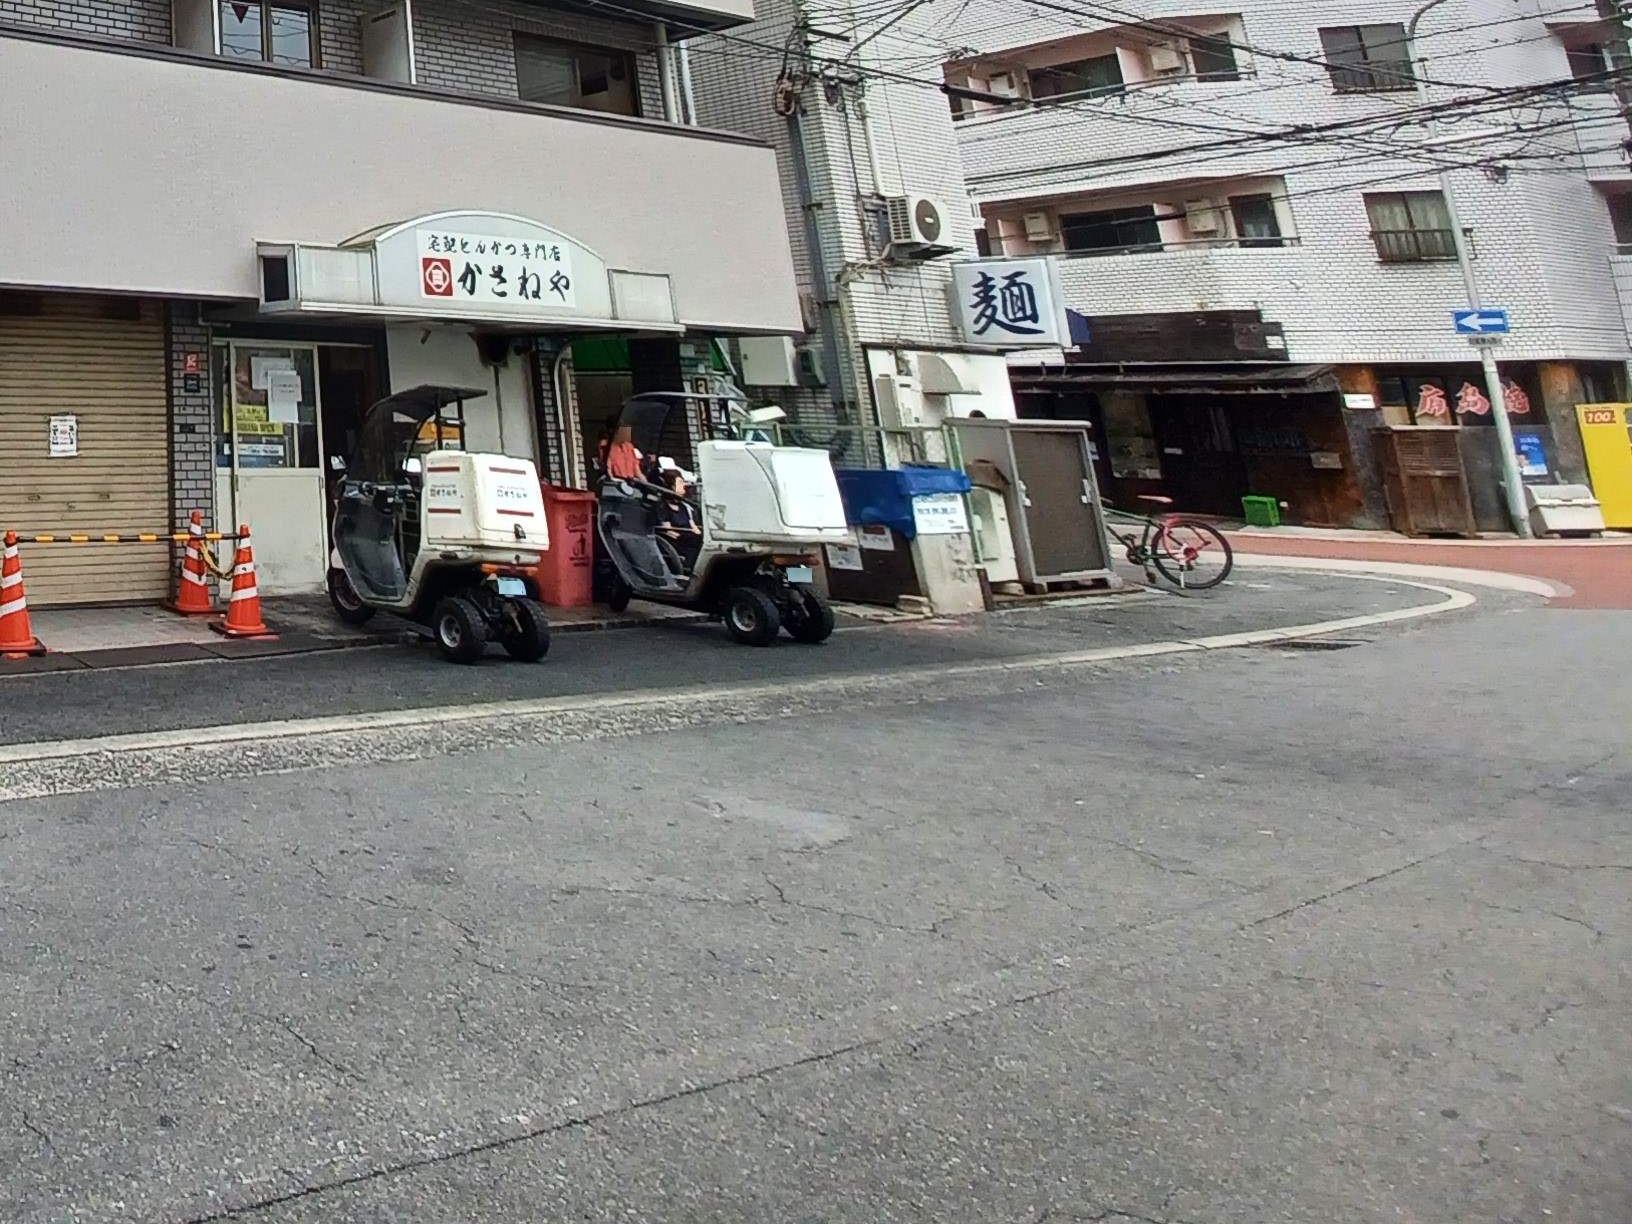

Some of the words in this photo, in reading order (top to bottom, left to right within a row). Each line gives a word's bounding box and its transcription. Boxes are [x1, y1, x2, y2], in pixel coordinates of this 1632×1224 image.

[457, 261, 571, 302] かさねや
[969, 270, 1046, 335] 麺
